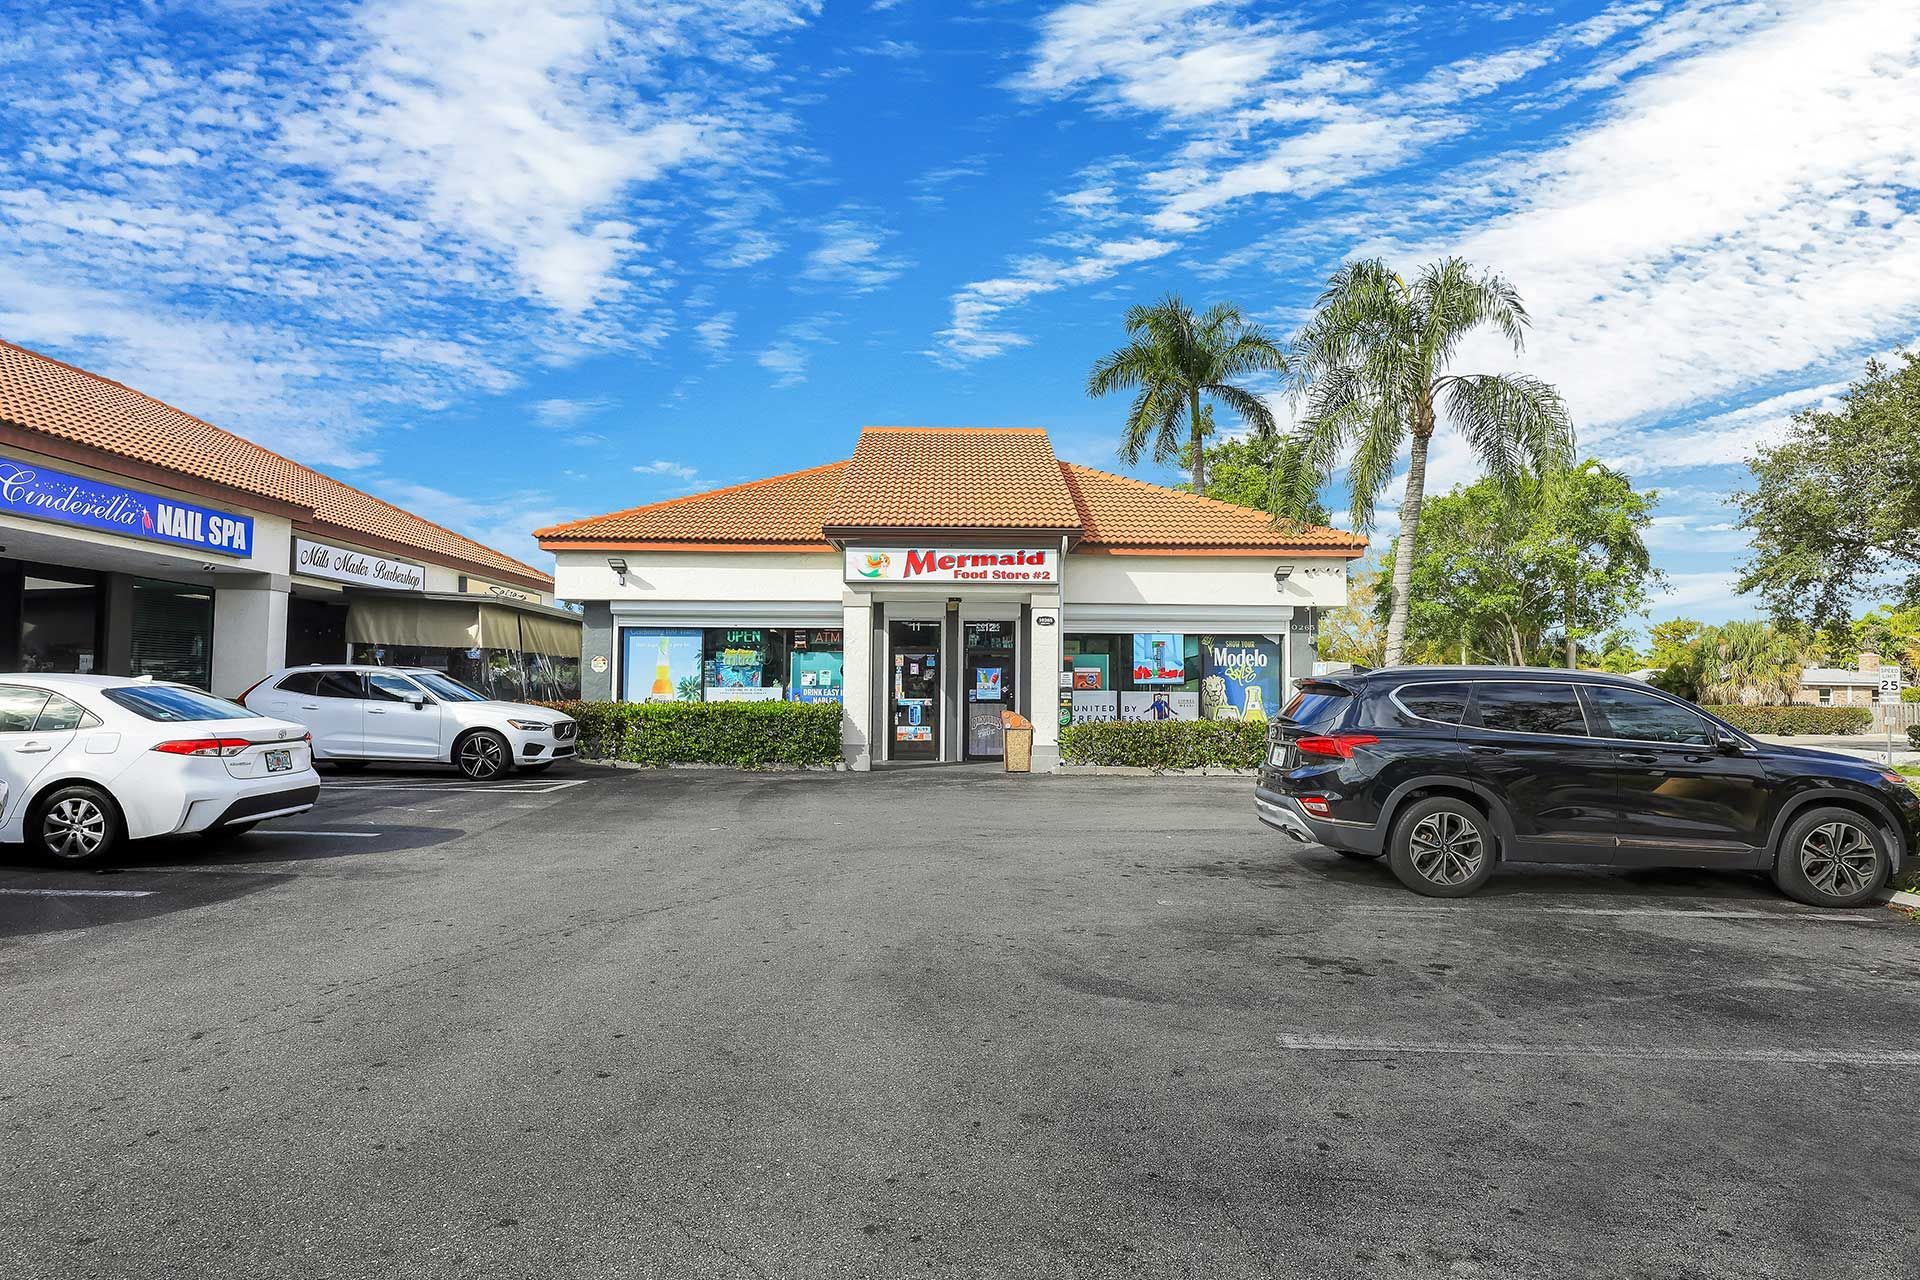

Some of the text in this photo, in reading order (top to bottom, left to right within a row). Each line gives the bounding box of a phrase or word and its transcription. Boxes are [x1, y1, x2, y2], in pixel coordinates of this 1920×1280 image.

[0, 463, 136, 526] Cinderella
[157, 504, 246, 550] NAIL SPA
[300, 544, 421, 591] Mills Master Barbershop
[903, 549, 1046, 579] Mermaid
[953, 570, 1050, 580] Food Store #2
[727, 631, 761, 643] OPEN
[815, 632, 840, 642] ATM
[1214, 647, 1268, 667] Modelo
[803, 688, 823, 696] DRINK
[823, 688, 840, 696] EASY
[1881, 680, 1899, 691] 25
